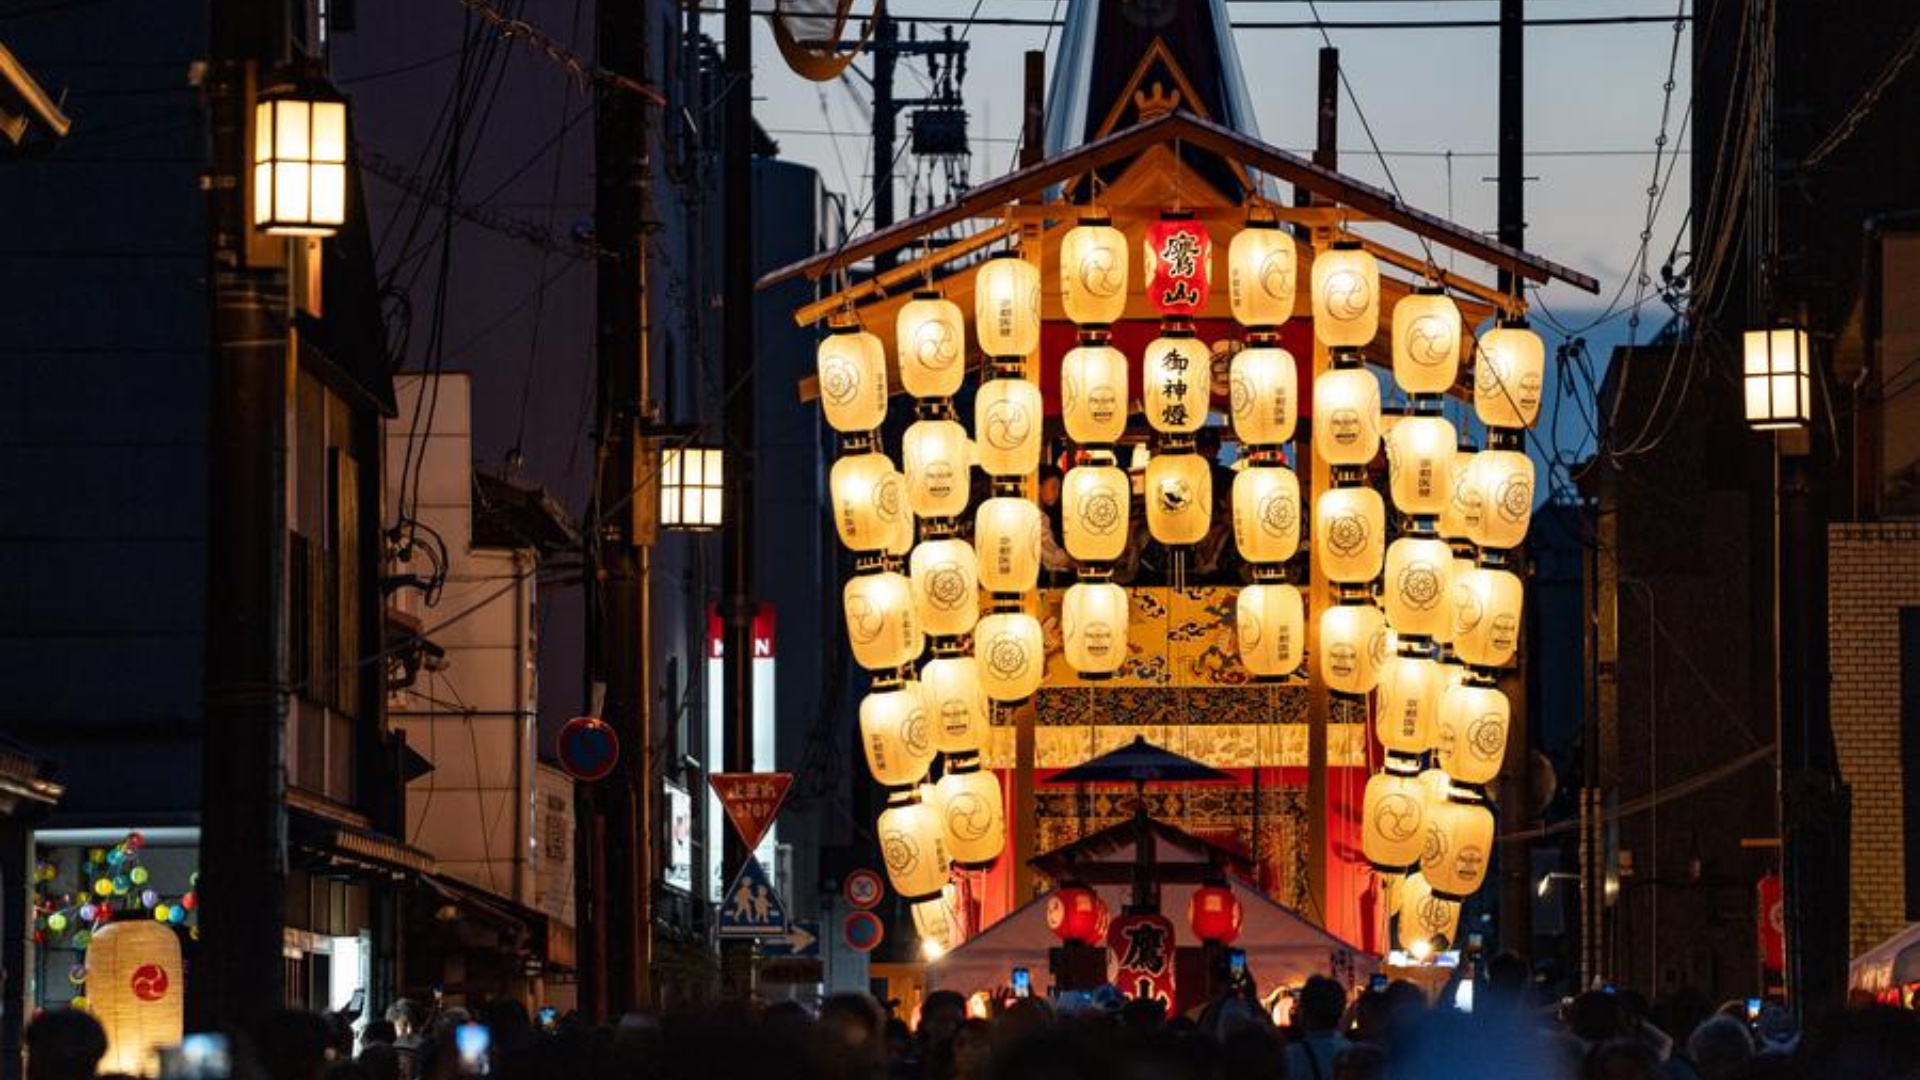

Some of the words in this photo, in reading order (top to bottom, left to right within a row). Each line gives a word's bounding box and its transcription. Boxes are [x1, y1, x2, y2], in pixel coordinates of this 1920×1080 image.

[1161, 232, 1201, 305] 鷹山
[1161, 347, 1189, 426] 御神燈
[733, 802, 771, 818] STOP
